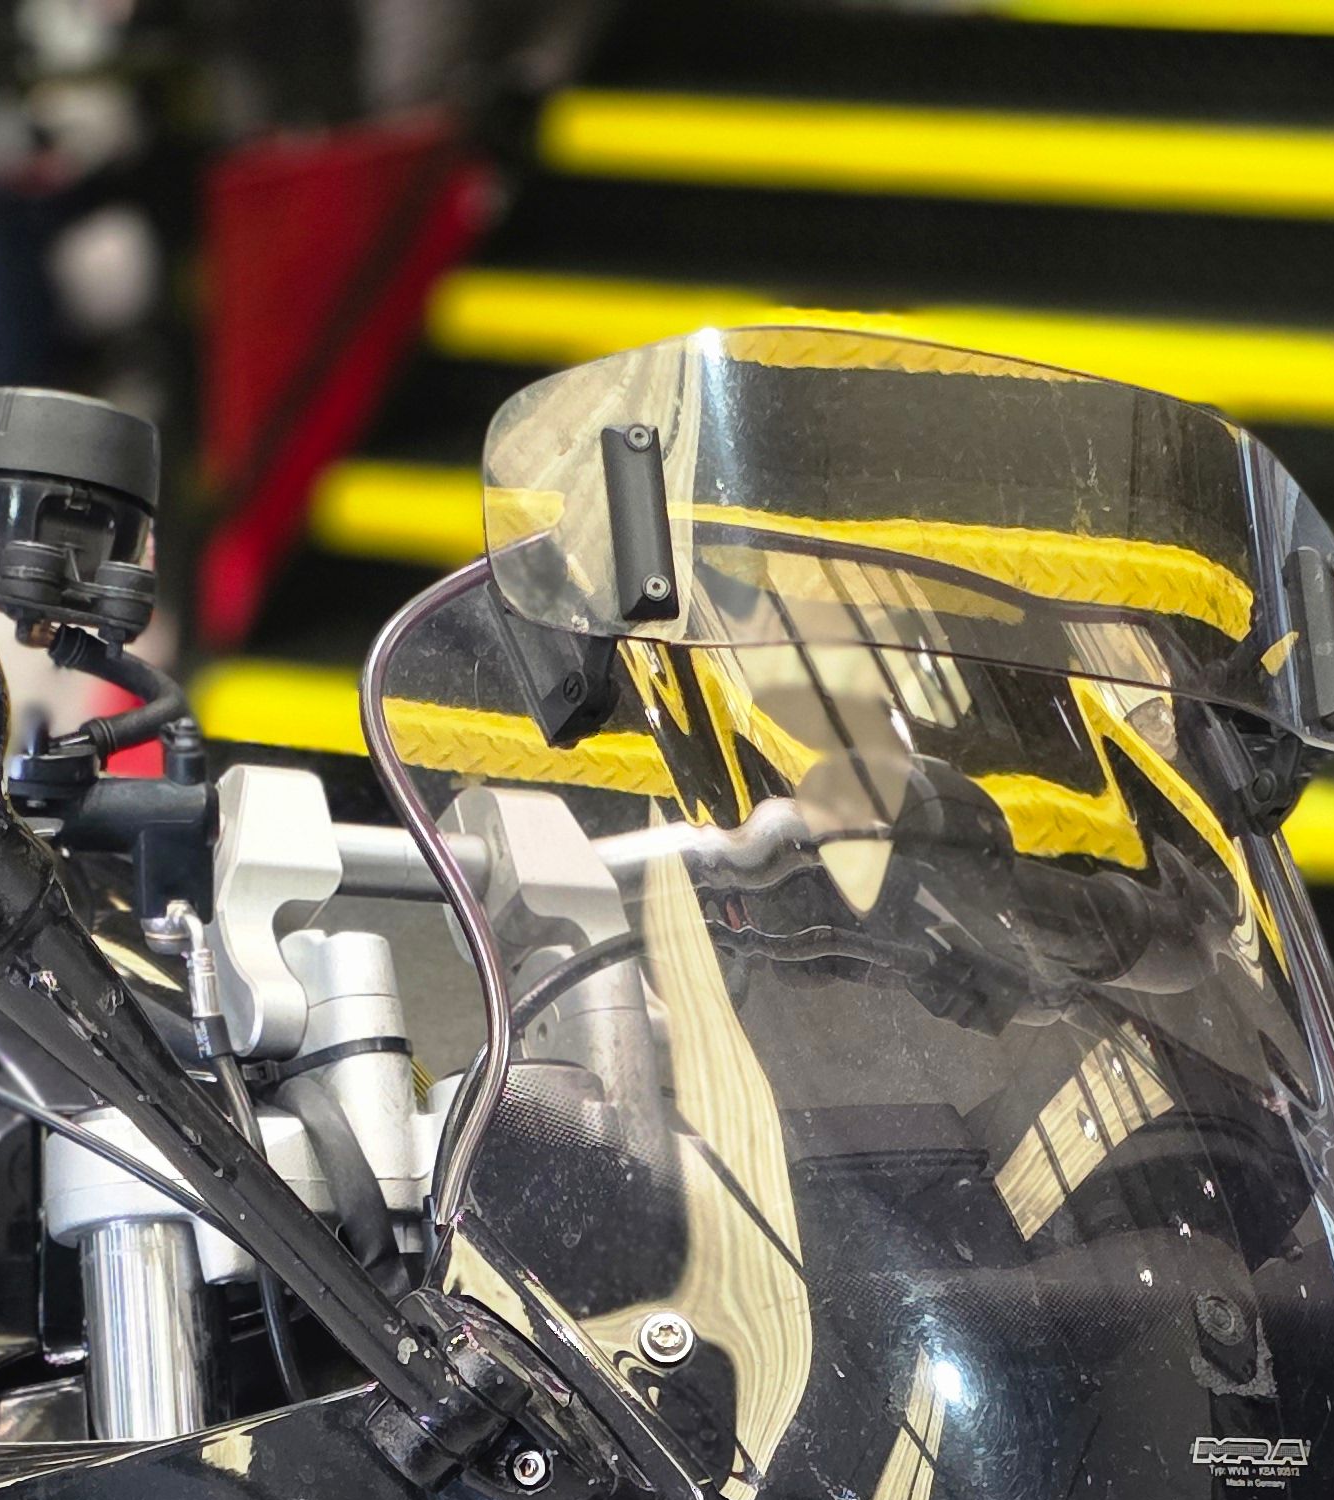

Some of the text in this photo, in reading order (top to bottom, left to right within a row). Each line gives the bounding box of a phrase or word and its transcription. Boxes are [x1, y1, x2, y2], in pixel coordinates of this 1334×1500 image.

[1192, 1437, 1308, 1465] MRA
[1225, 1478, 1286, 1490] Made in Germany
